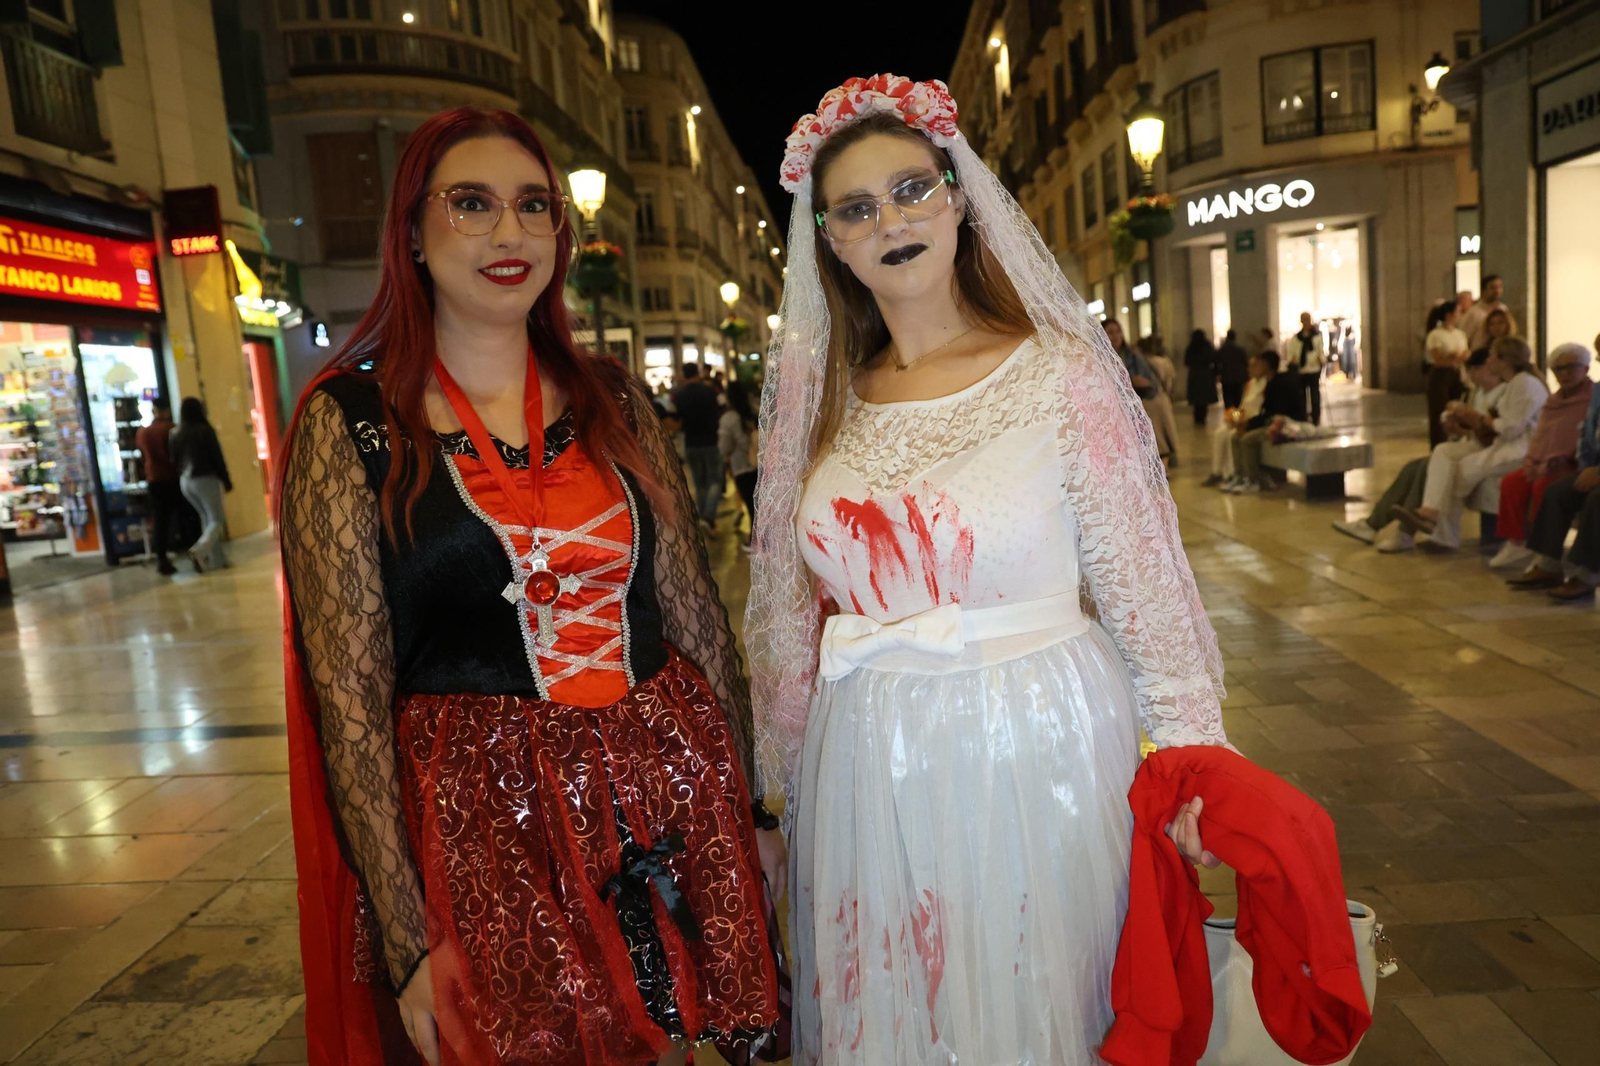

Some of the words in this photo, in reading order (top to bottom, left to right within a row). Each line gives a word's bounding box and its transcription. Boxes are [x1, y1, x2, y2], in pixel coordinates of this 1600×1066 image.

[1187, 179, 1315, 227] MANGO
[18, 230, 97, 263] TABACOS
[62, 274, 122, 301] LARIOS
